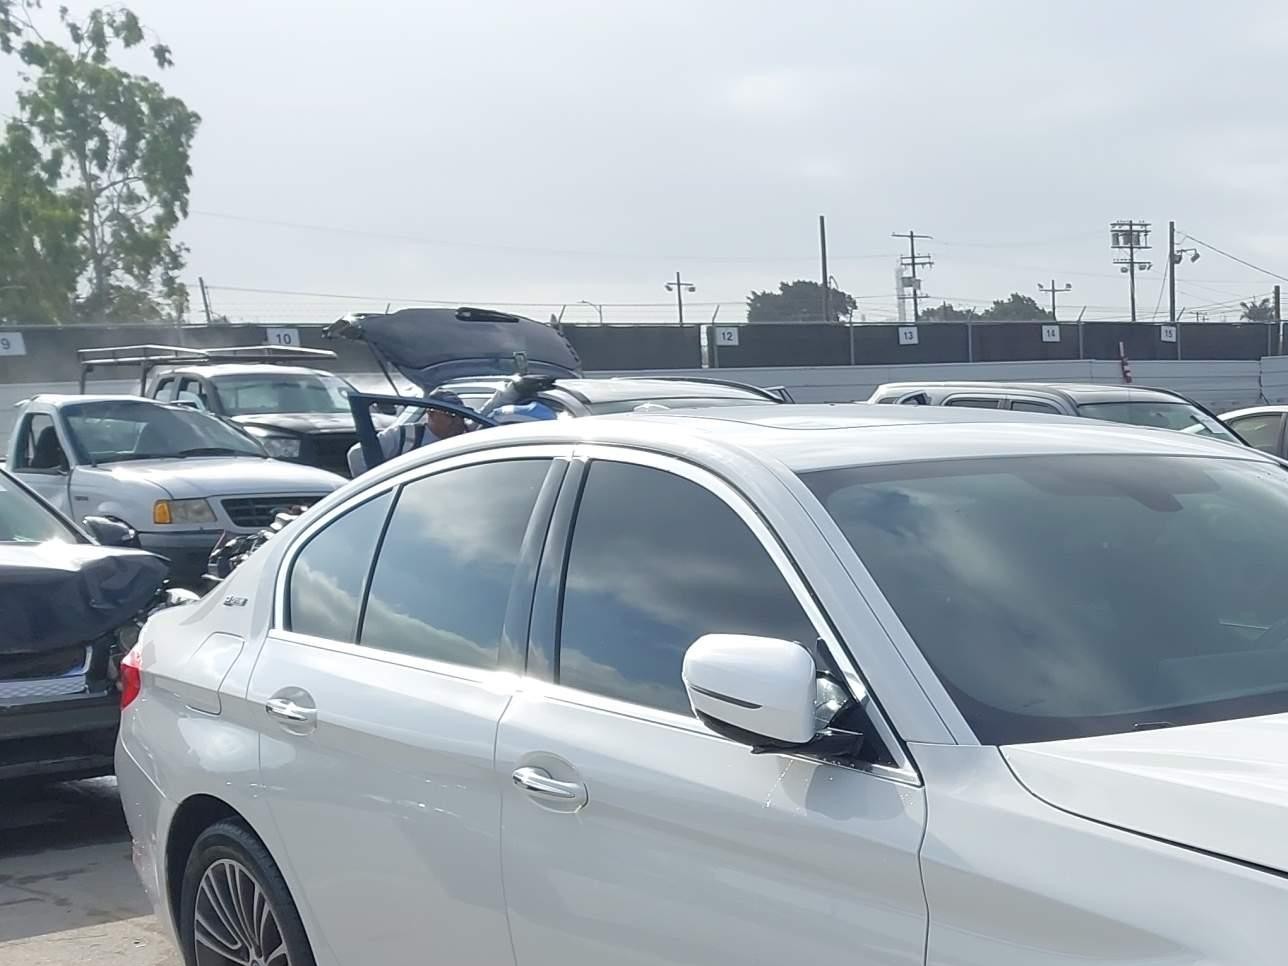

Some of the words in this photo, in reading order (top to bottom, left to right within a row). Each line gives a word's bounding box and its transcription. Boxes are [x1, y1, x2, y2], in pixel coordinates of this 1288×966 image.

[722, 331, 734, 342] 12
[904, 331, 914, 340] 13
[1047, 329, 1056, 337] 14
[1, 338, 10, 350] 9
[276, 333, 292, 345] 10
